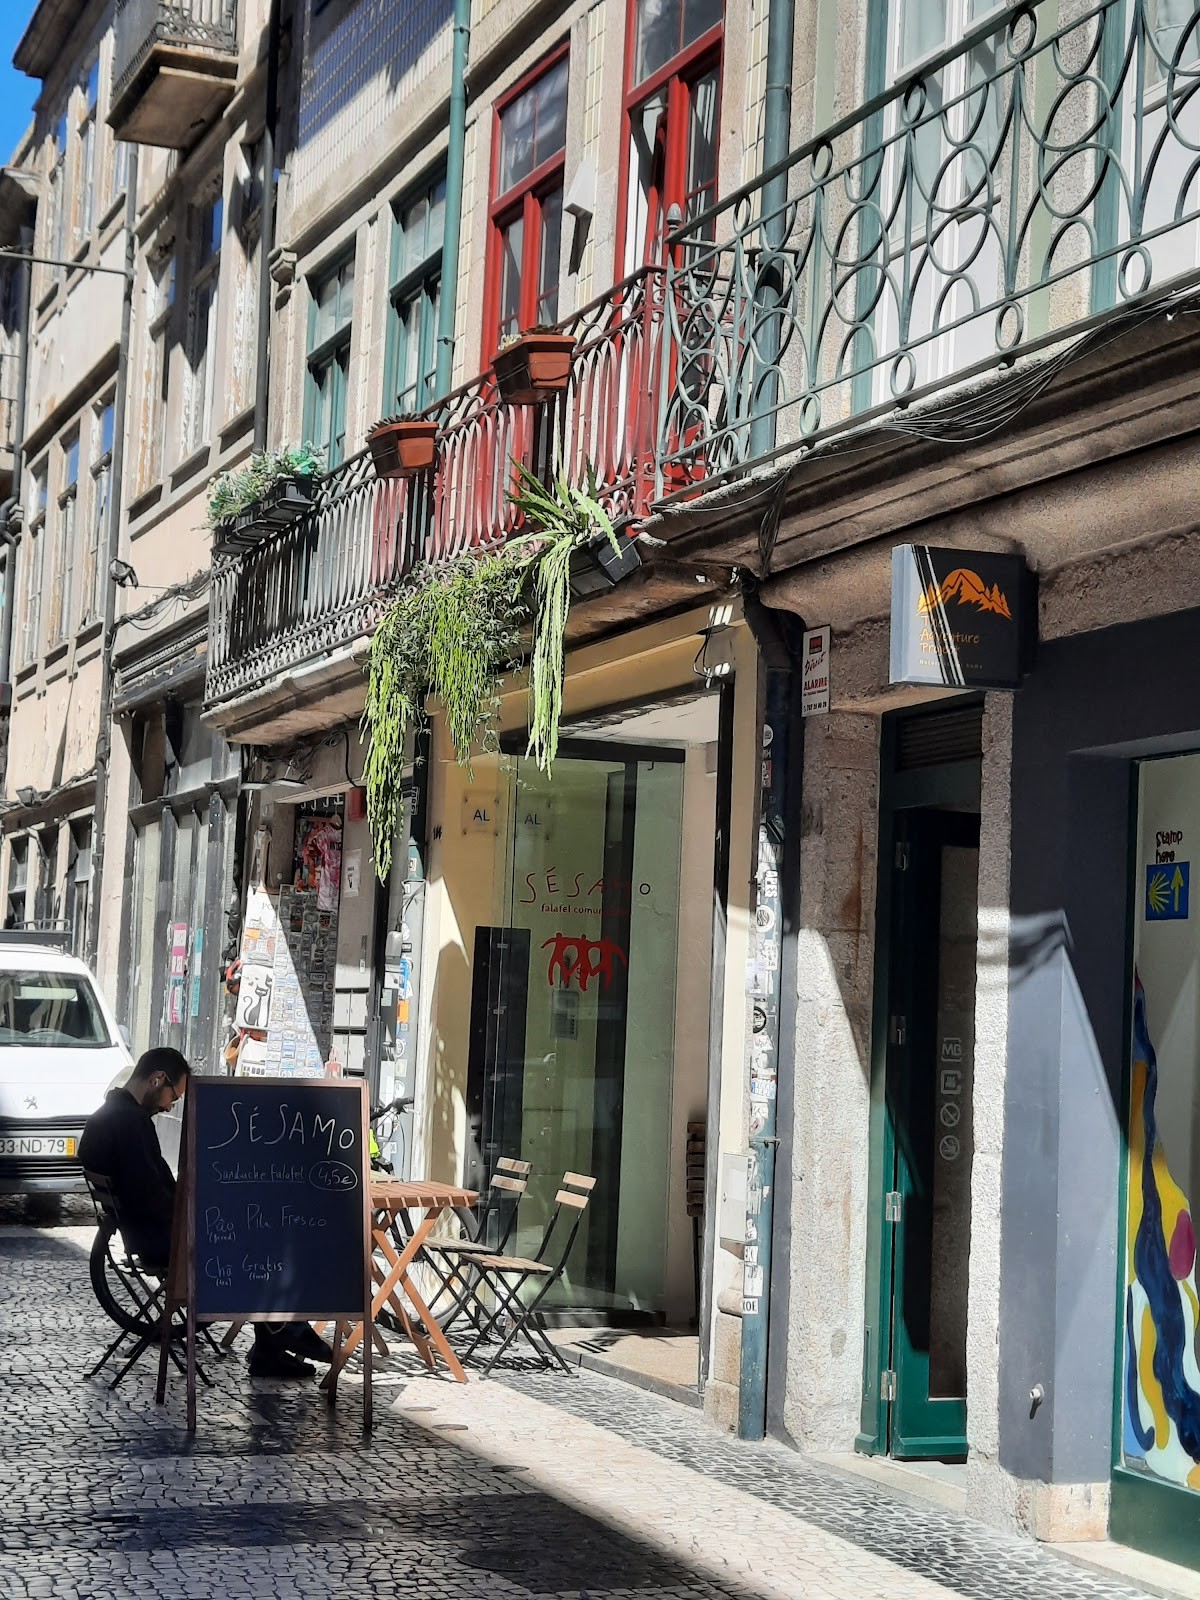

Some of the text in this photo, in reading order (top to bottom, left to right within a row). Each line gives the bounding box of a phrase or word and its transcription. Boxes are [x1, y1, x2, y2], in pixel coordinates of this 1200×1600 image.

[473, 809, 490, 822] AL
[524, 813, 541, 825] AL
[541, 904, 571, 913] falafel
[207, 1102, 355, 1155] SÉSAMO
[281, 1205, 327, 1226] Fresco
[242, 1254, 282, 1272] Gratis
